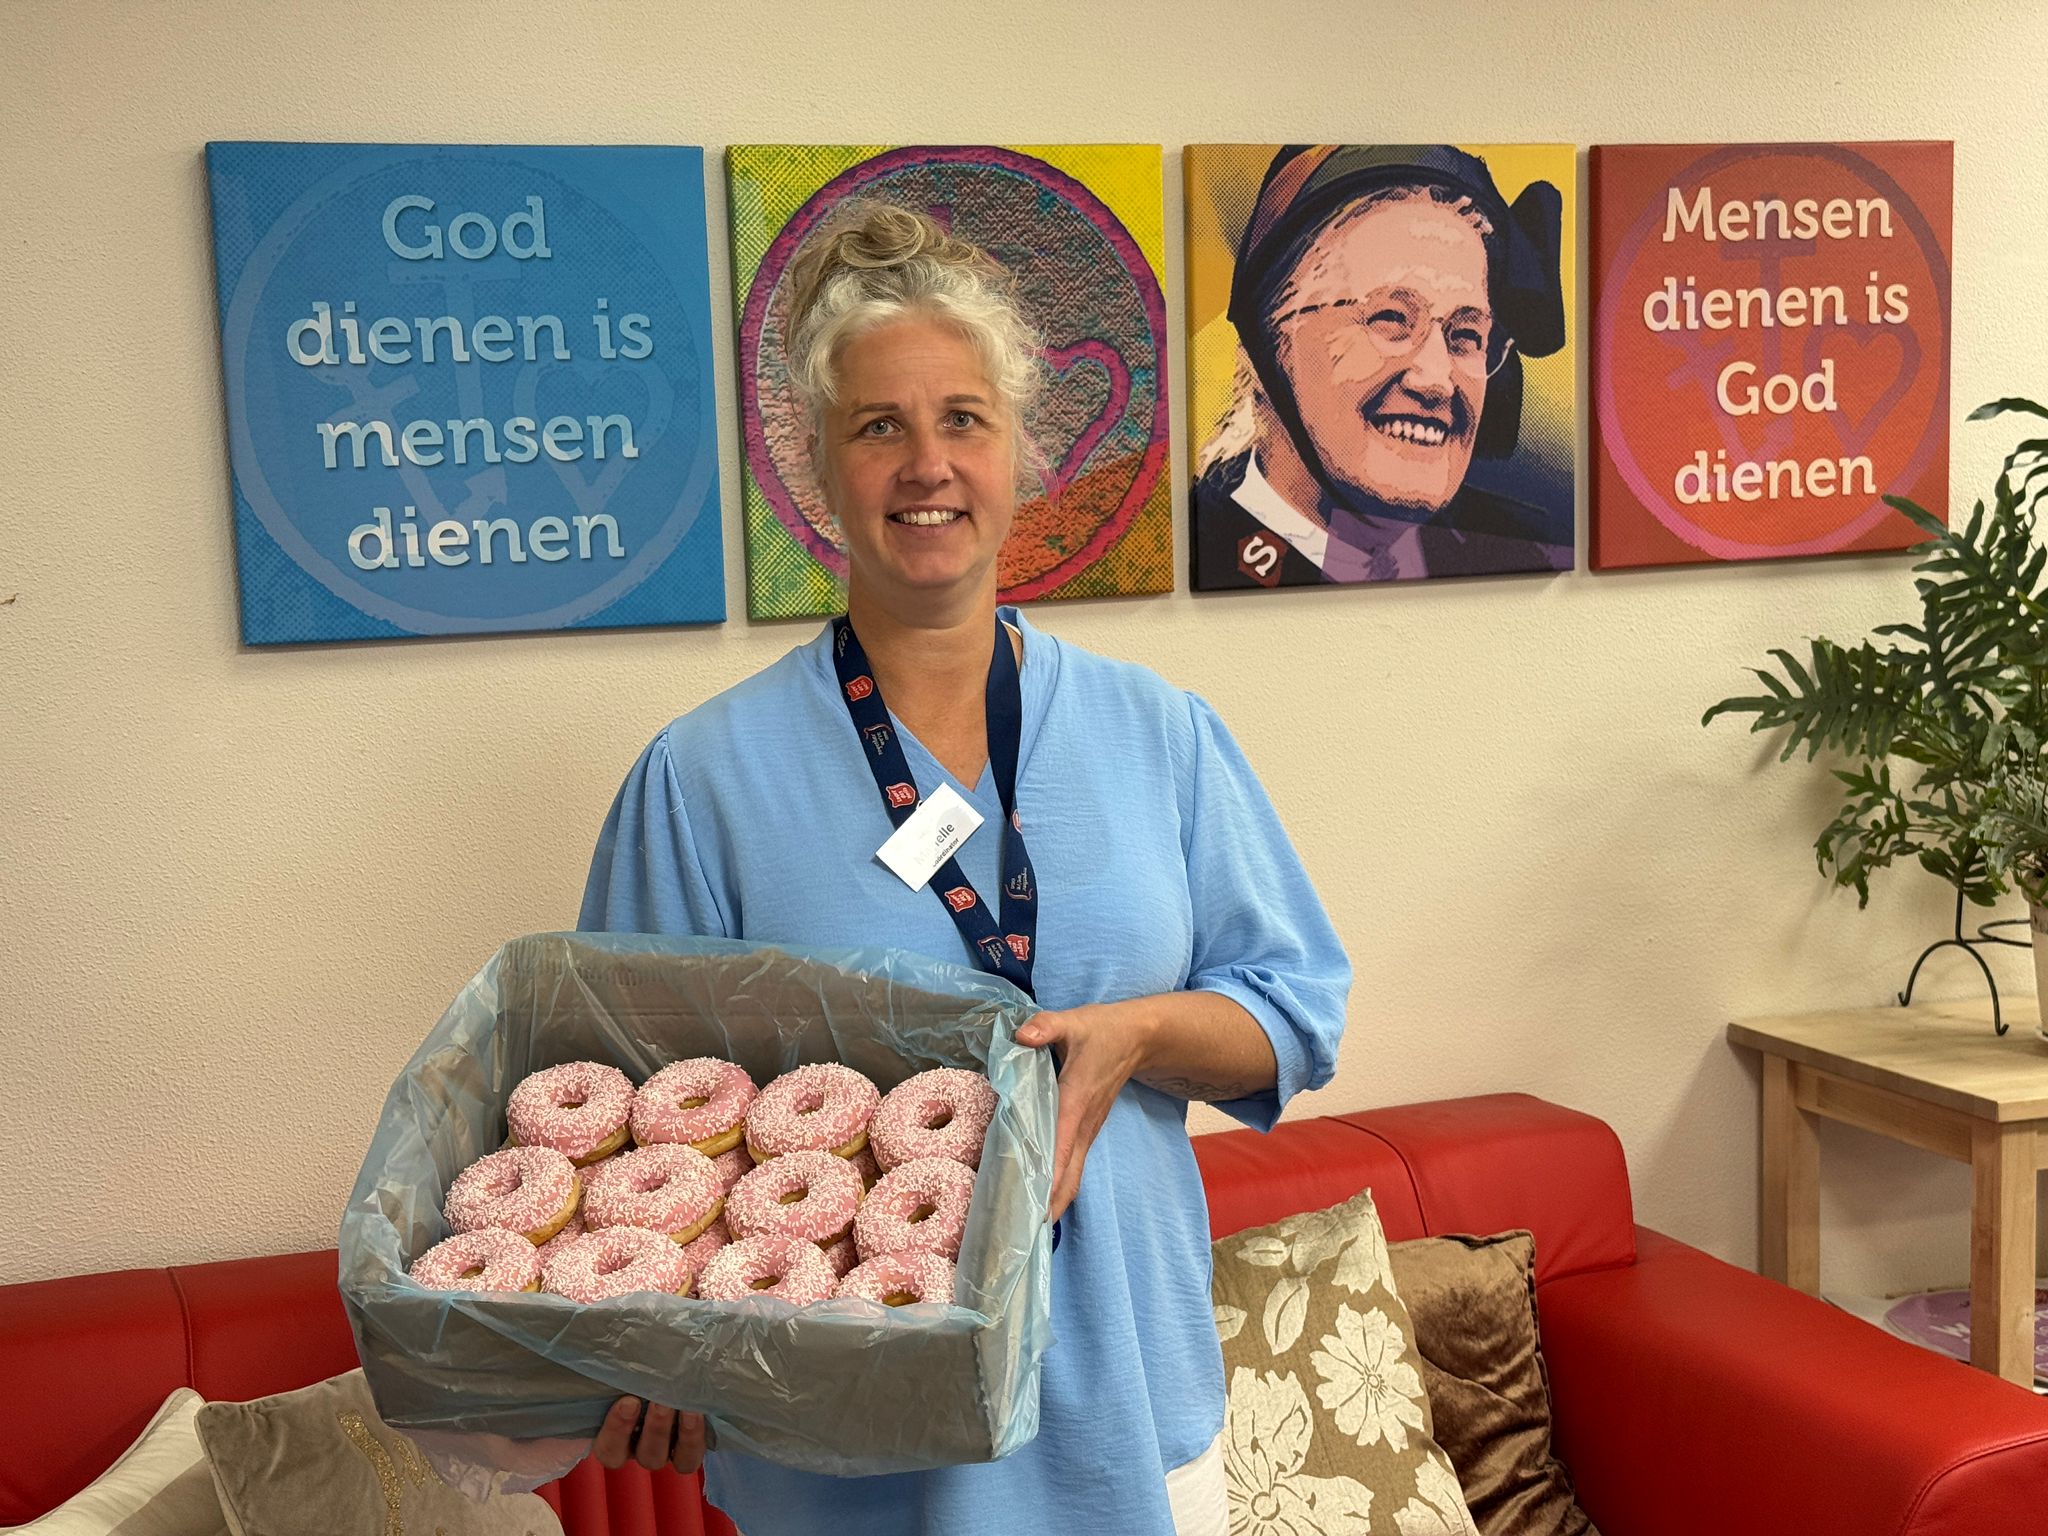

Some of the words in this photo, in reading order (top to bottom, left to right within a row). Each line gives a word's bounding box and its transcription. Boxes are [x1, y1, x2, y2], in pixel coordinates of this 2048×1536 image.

[382, 194, 552, 260] God
[1662, 187, 1893, 243] Mensen
[1643, 276, 1847, 332] dienen
[1865, 271, 1910, 325] is
[286, 301, 571, 366] dienen
[593, 298, 655, 361] is
[1717, 358, 1838, 416] God
[317, 413, 640, 469] mensen
[1674, 450, 1876, 505] dienen
[348, 505, 626, 570] dienen
[1243, 536, 1278, 576] S
